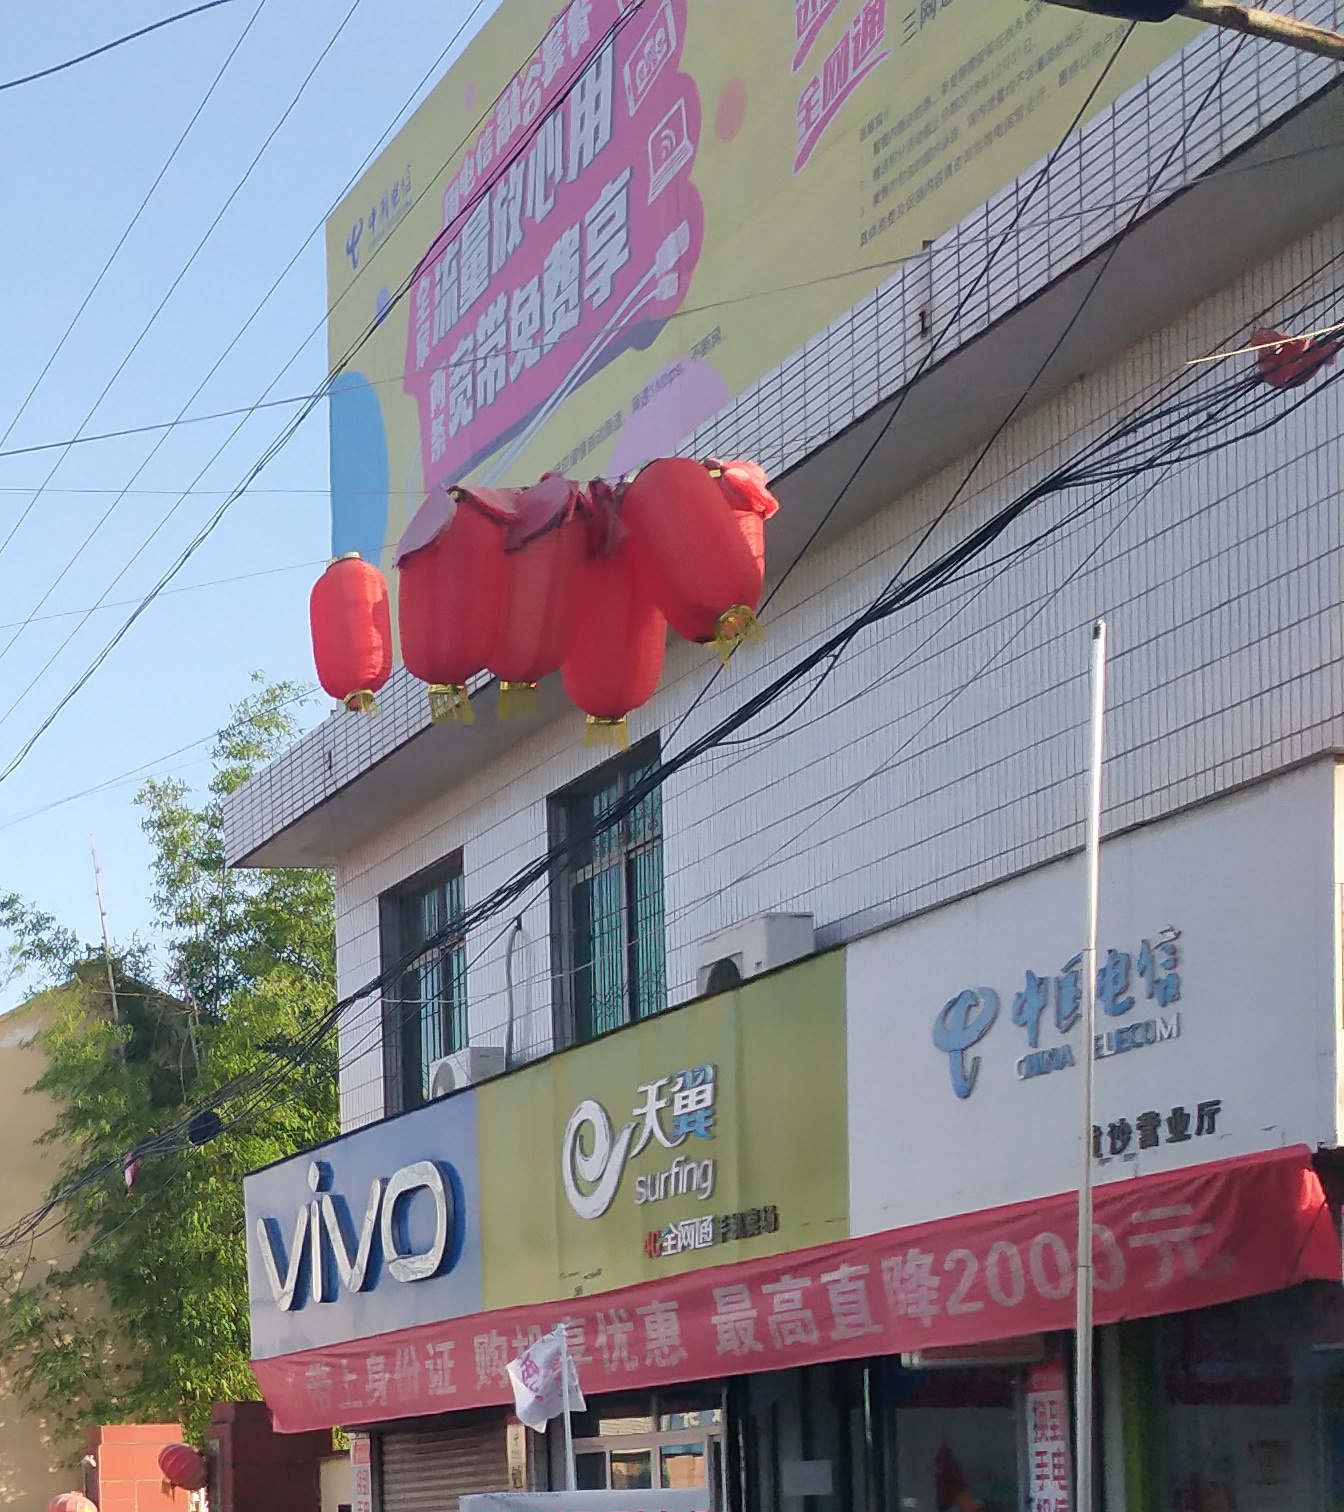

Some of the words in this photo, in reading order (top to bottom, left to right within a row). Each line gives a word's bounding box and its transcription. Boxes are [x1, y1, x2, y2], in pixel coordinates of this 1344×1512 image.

[432, 30, 615, 348] 流量放心用
[448, 165, 632, 440] 宽带免费享
[628, 1063, 716, 1160] 天翼
[634, 1155, 716, 1206] surfing
[256, 1160, 458, 1312] vivo
